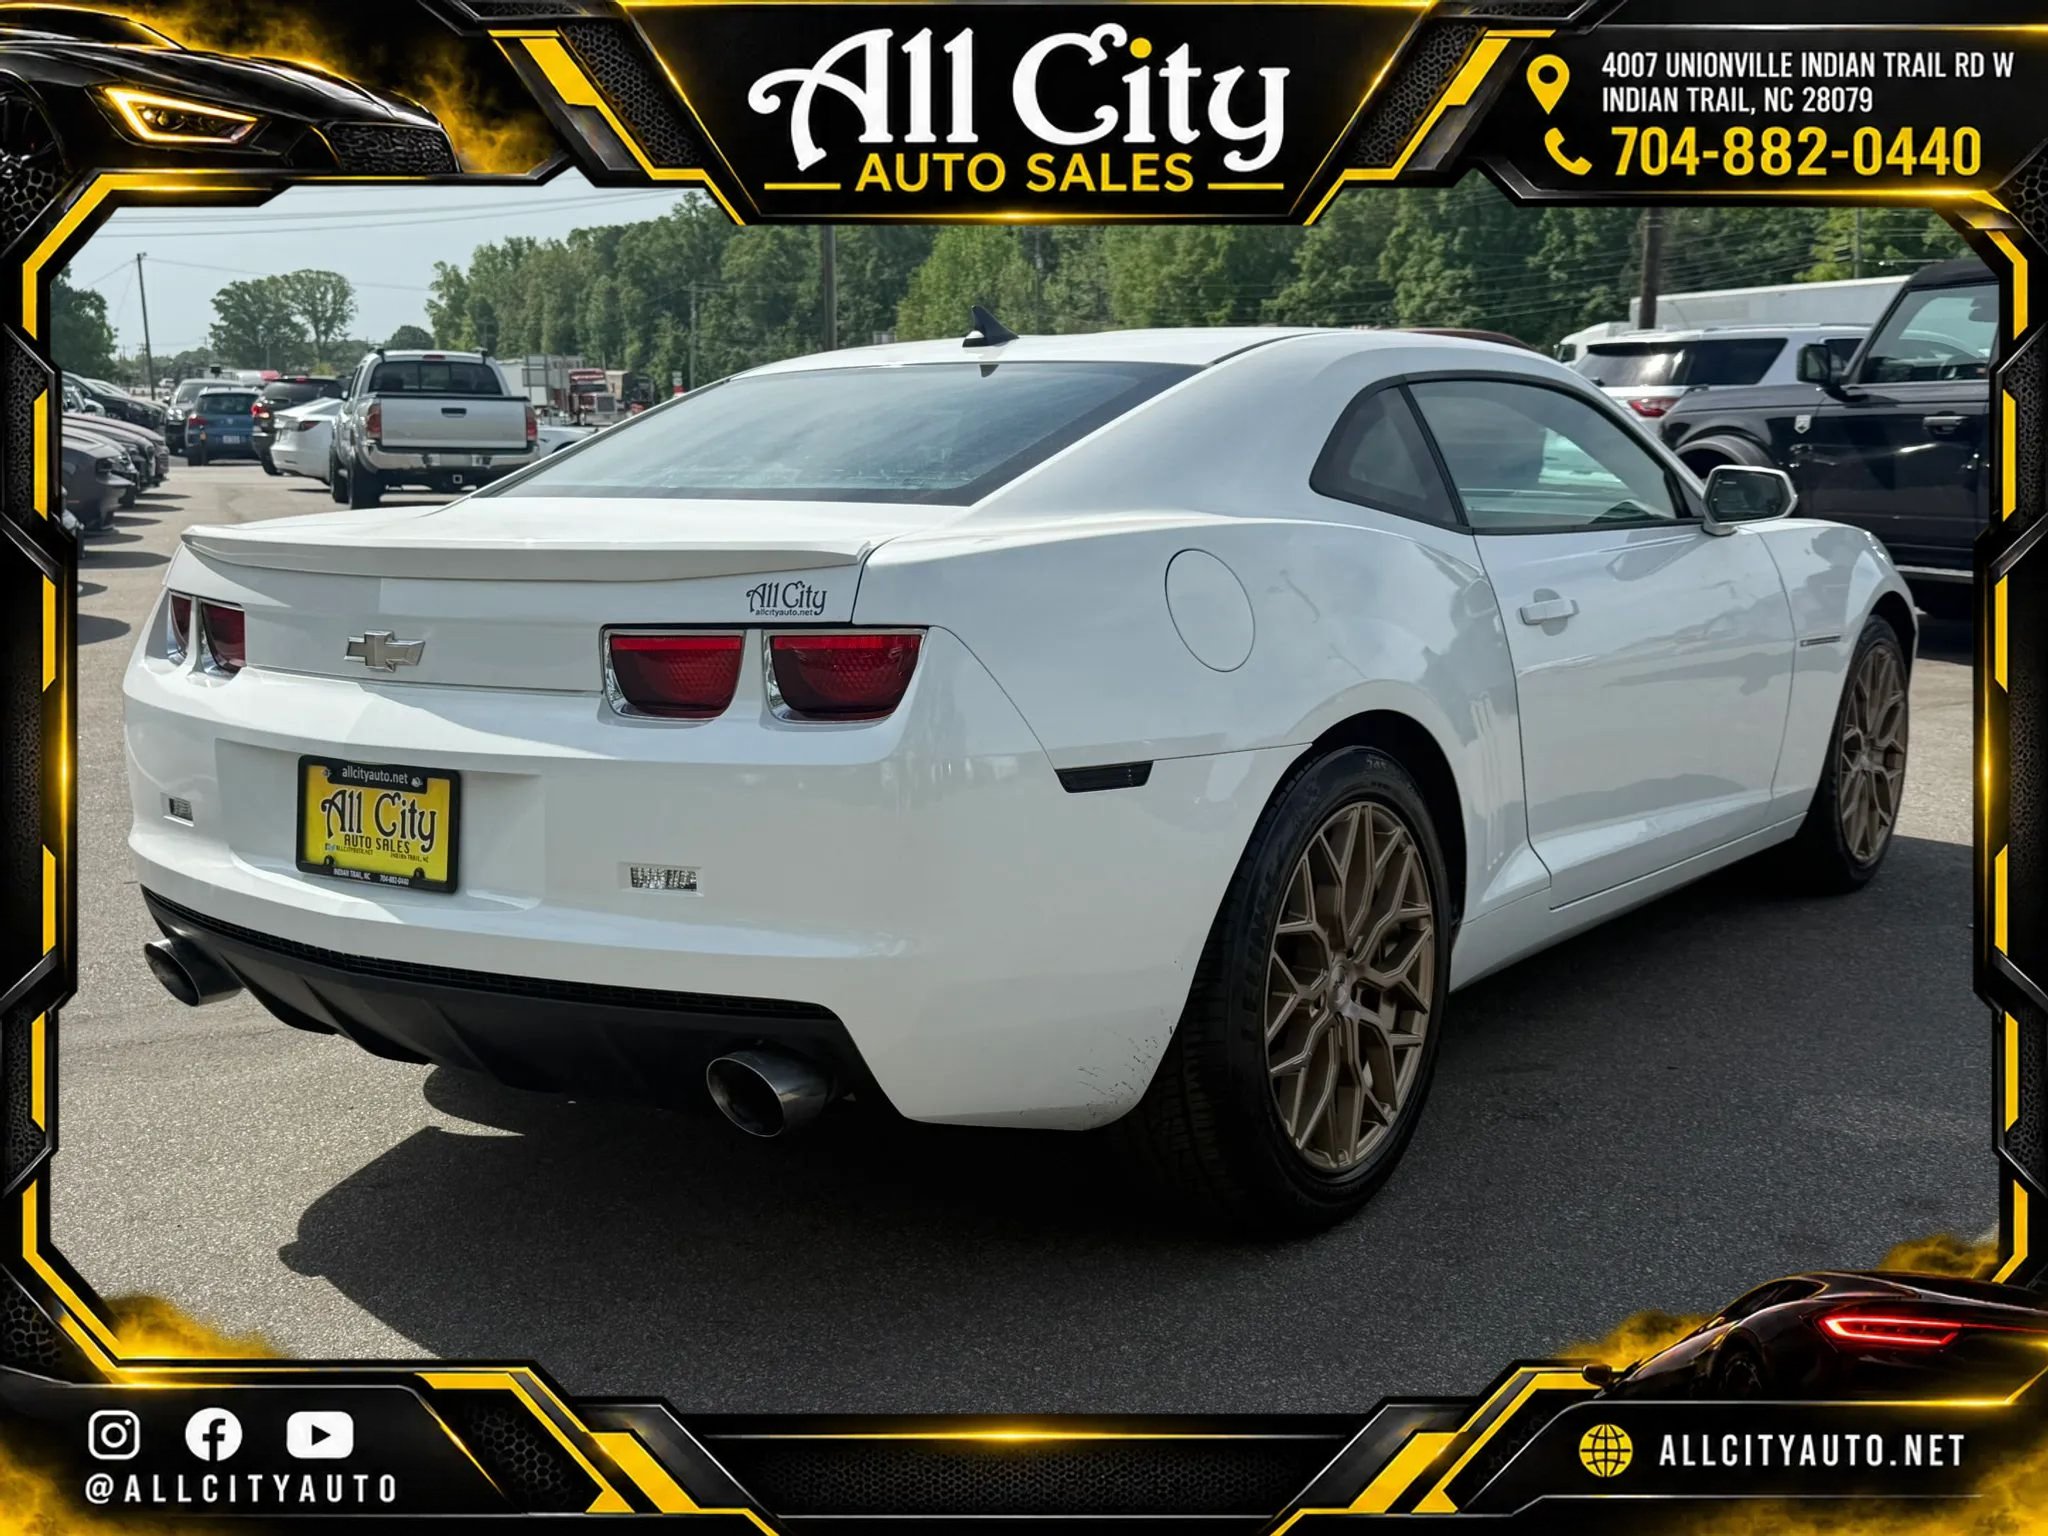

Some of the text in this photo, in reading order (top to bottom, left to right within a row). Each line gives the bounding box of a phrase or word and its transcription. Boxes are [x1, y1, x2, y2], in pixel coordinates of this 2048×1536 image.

[746, 580, 828, 616] All City
[755, 609, 813, 617] allcityauto.net
[342, 766, 408, 785] allcityauto.net
[321, 789, 437, 853] All City
[344, 834, 410, 854] AUTO SALES
